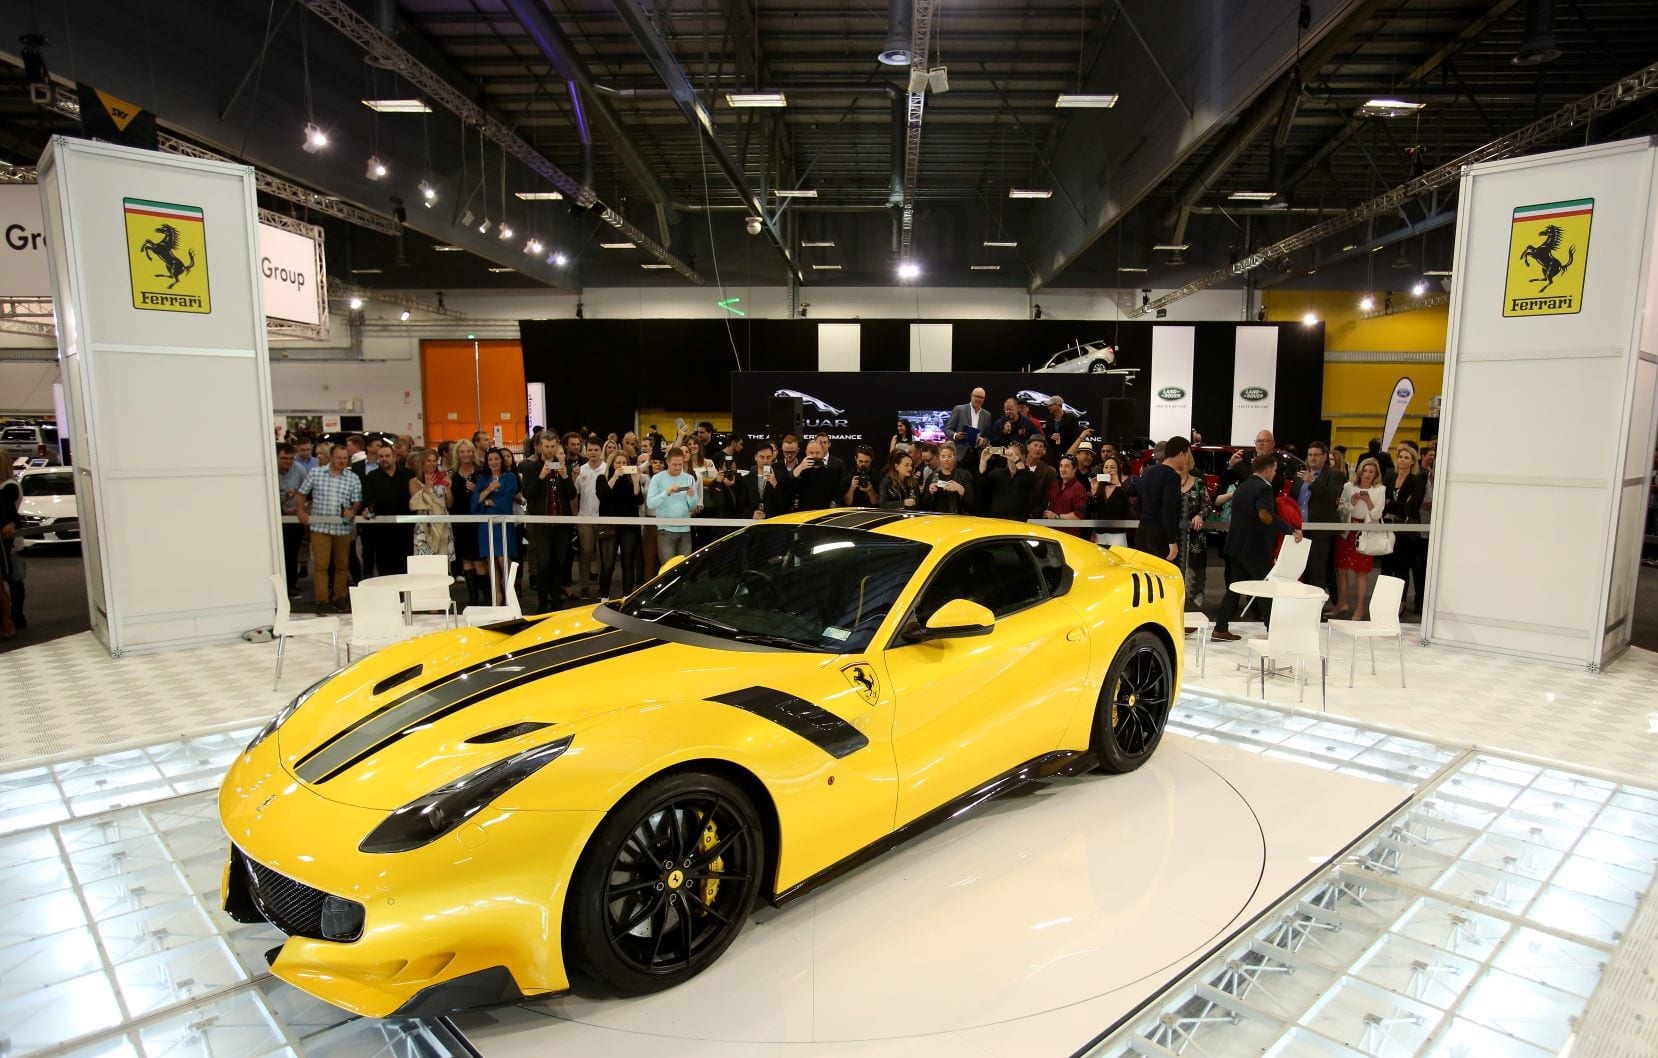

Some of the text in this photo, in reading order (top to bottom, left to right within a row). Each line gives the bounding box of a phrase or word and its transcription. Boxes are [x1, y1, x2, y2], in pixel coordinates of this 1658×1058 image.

[5, 223, 48, 251] Gr
[261, 256, 305, 292] Group
[141, 291, 203, 308] Ferrari
[1510, 295, 1573, 312] Ferrari
[800, 418, 849, 428] UAR
